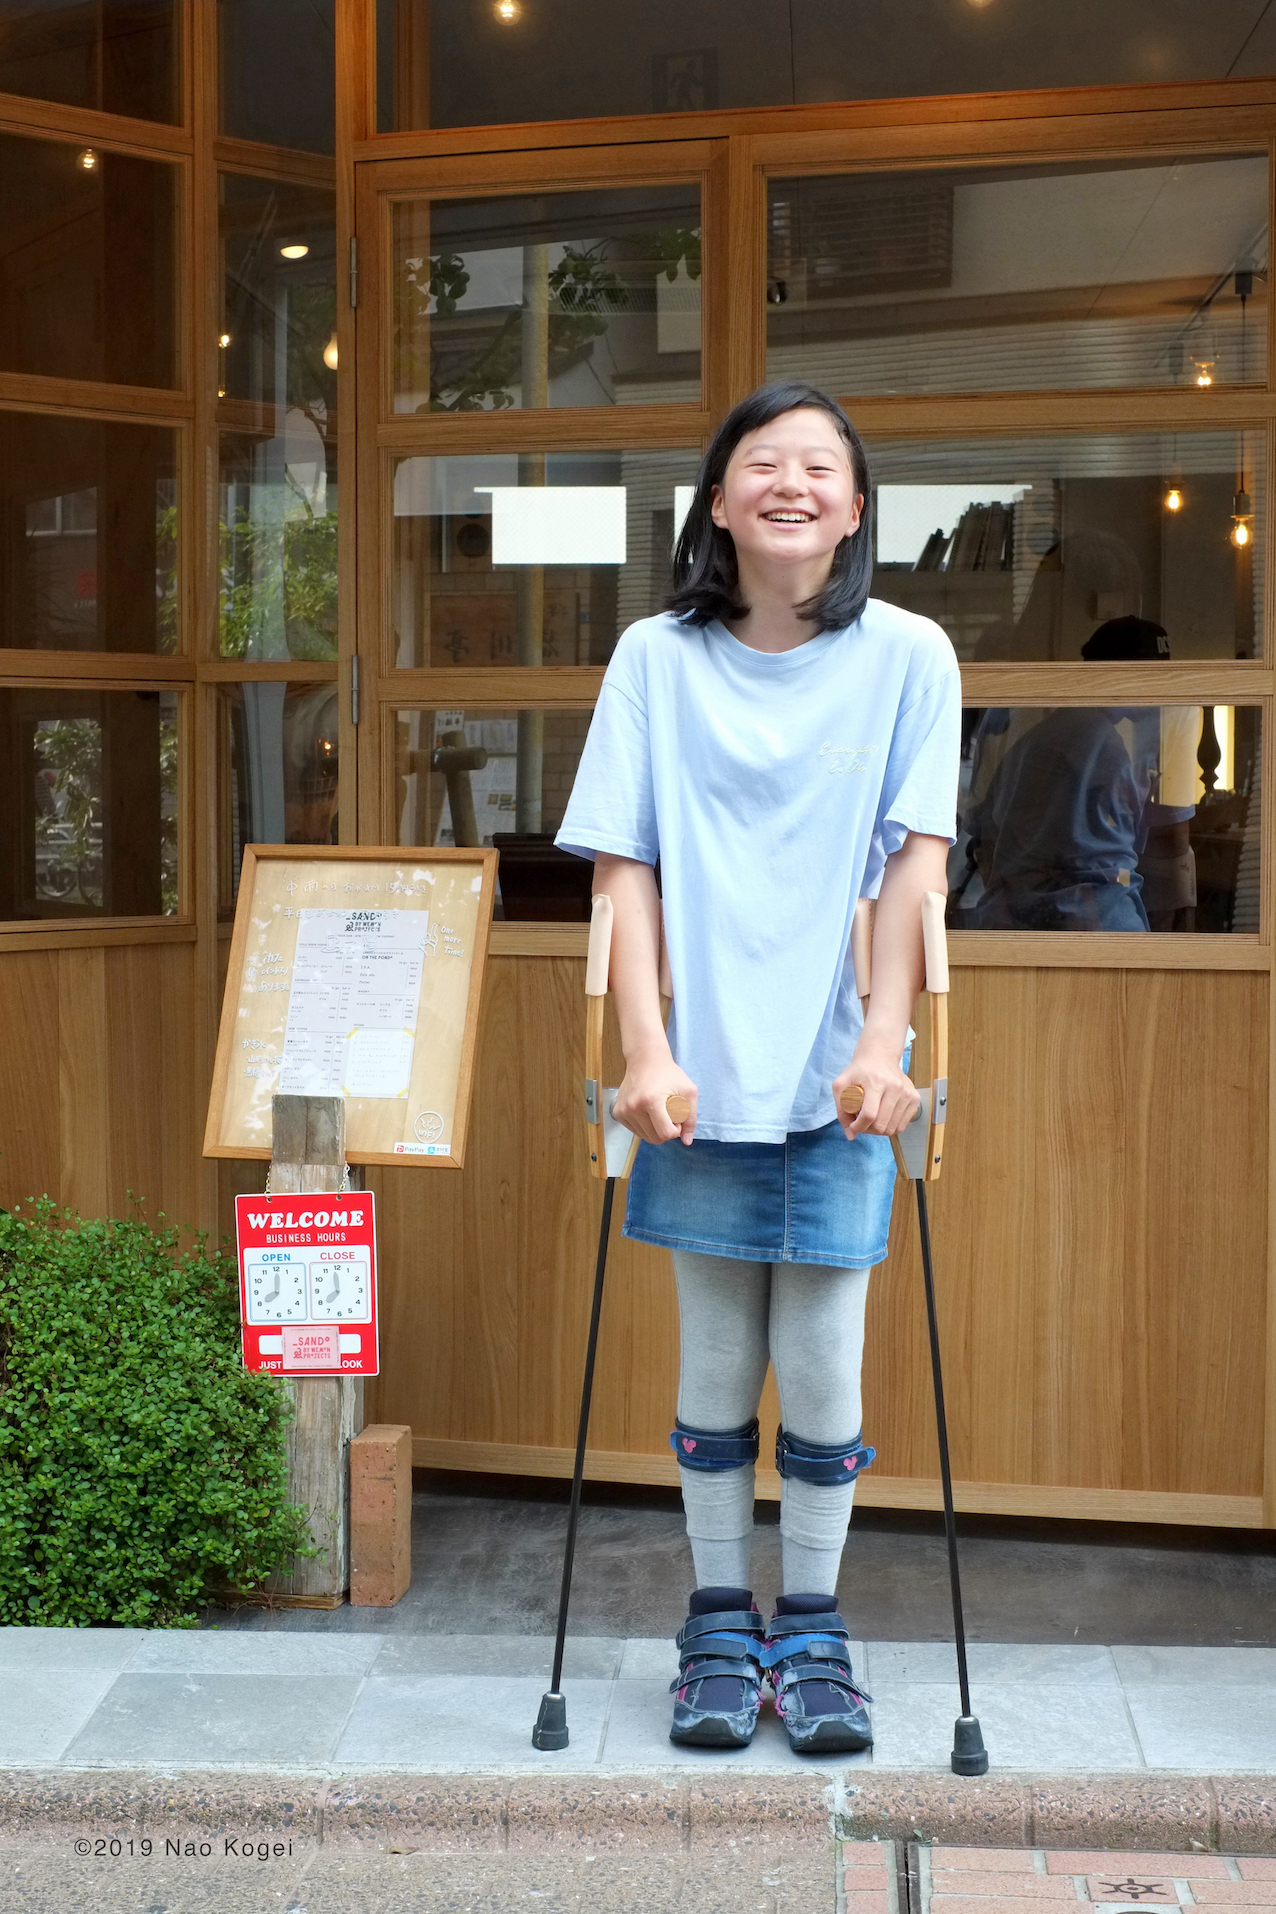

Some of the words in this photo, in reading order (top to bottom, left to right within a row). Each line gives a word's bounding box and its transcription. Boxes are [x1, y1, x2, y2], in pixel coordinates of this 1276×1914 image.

[440, 926, 455, 934] One
[443, 935, 461, 945] more
[444, 945, 465, 958] time!
[247, 1210, 364, 1229] WELCOME
[266, 1233, 311, 1243] BUSINESS
[317, 1232, 346, 1242] HOURS
[262, 1253, 291, 1262] OPEN
[320, 1251, 355, 1260] CLOSE
[258, 1361, 282, 1369] JUST
[340, 1360, 363, 1369] OOK
